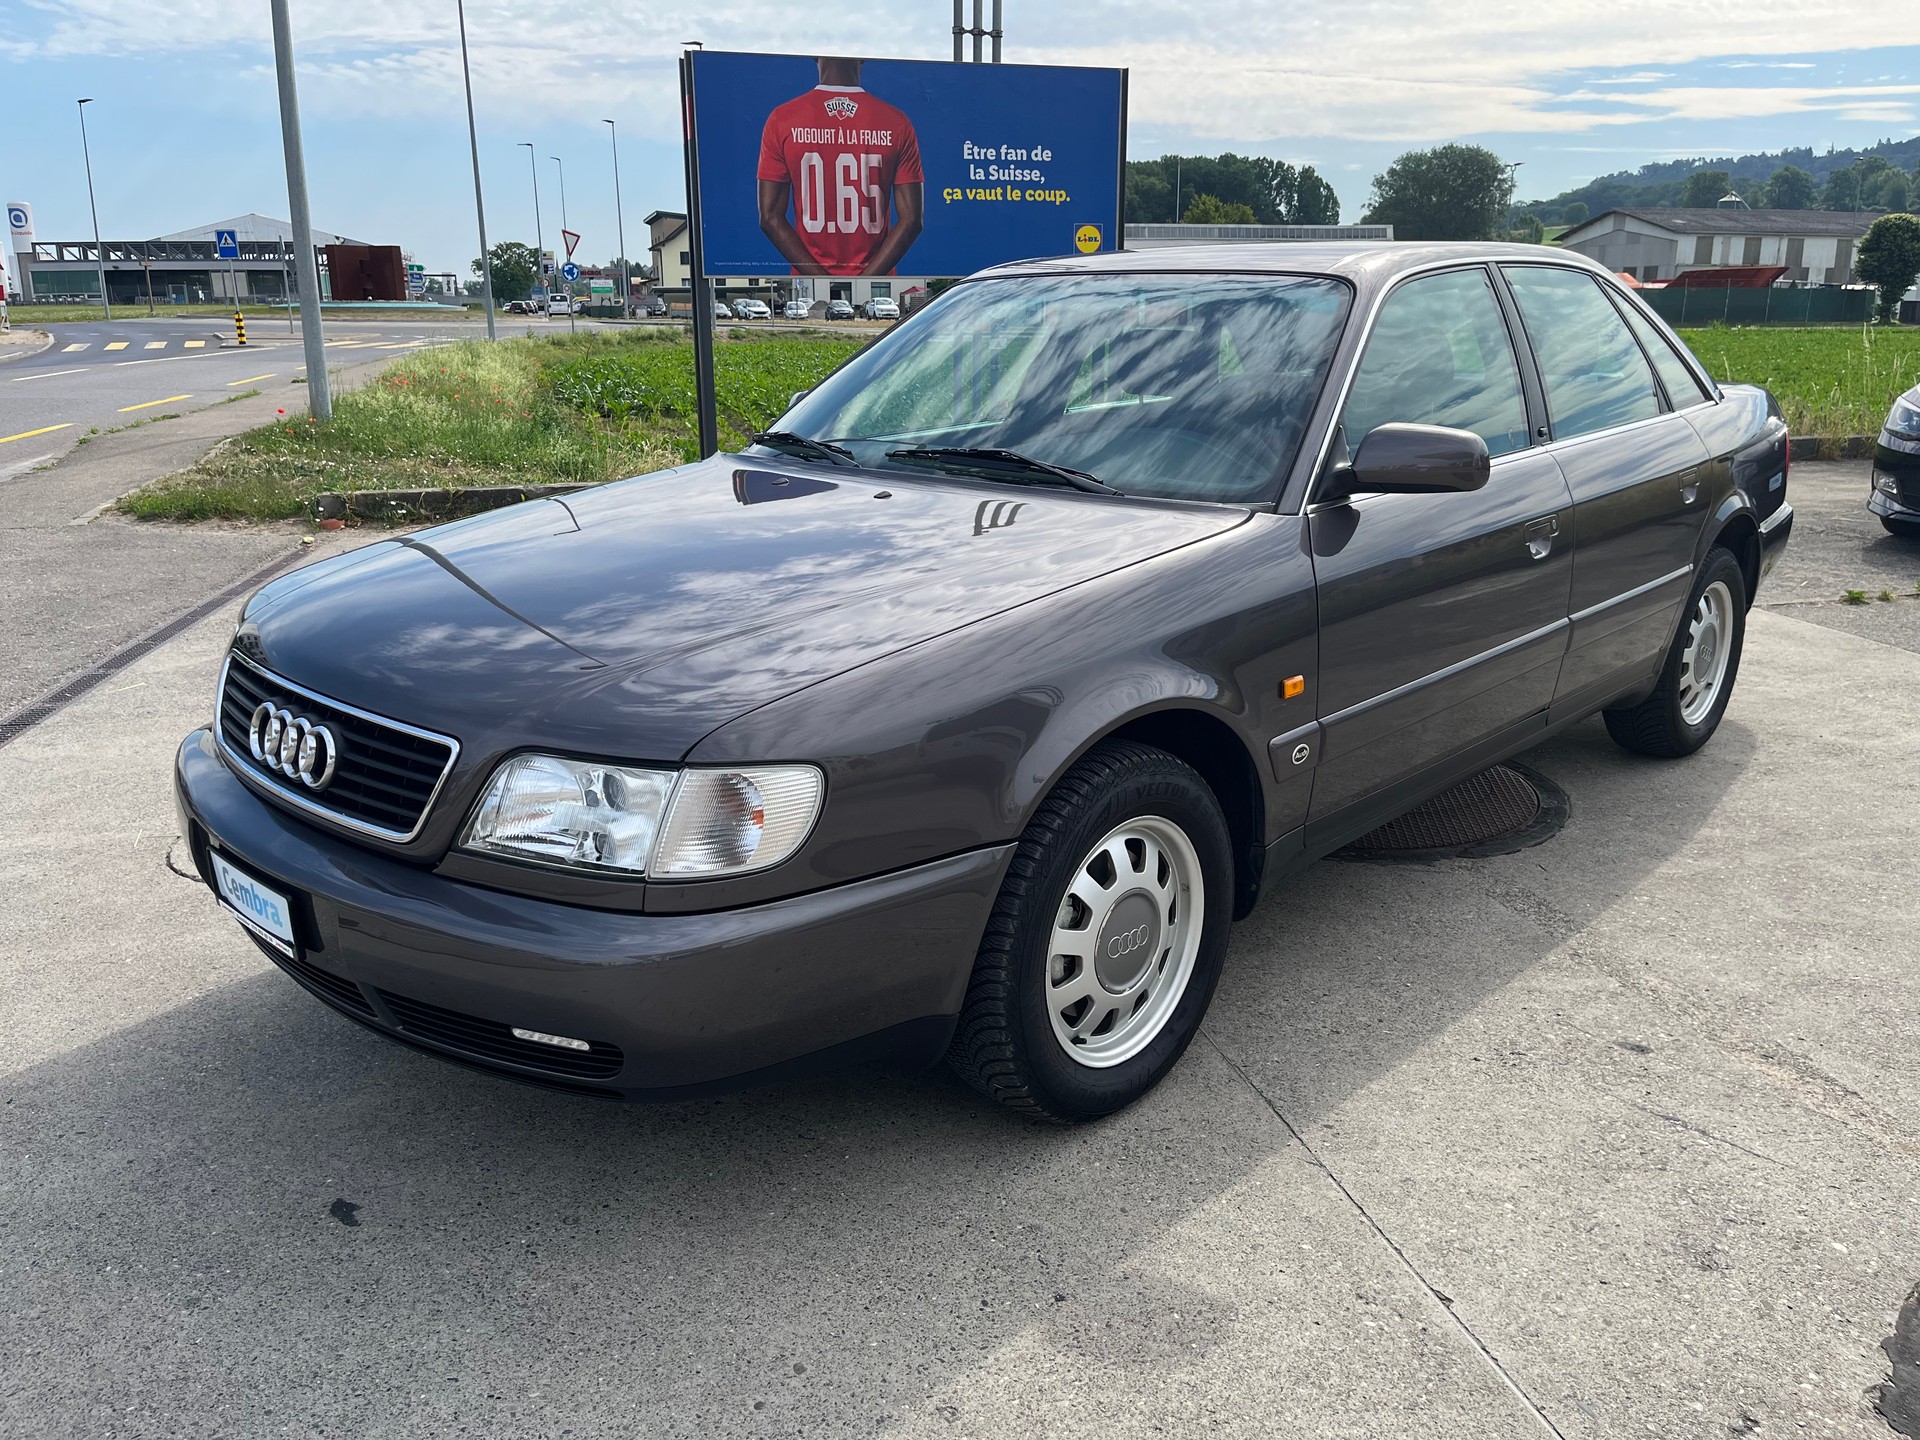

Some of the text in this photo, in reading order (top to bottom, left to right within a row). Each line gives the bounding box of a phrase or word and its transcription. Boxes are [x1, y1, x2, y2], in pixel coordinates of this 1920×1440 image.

[826, 101, 856, 115] SUISSE
[791, 126, 892, 146] YOGOURT À LA FRAISE
[963, 140, 1052, 161] Être fan de
[969, 164, 1045, 184] la Suisse,
[801, 152, 885, 235] 0.65
[943, 185, 1071, 206] ça vaut le coup.
[1136, 782, 1190, 799] VECTOR
[222, 866, 283, 928] Cembra
